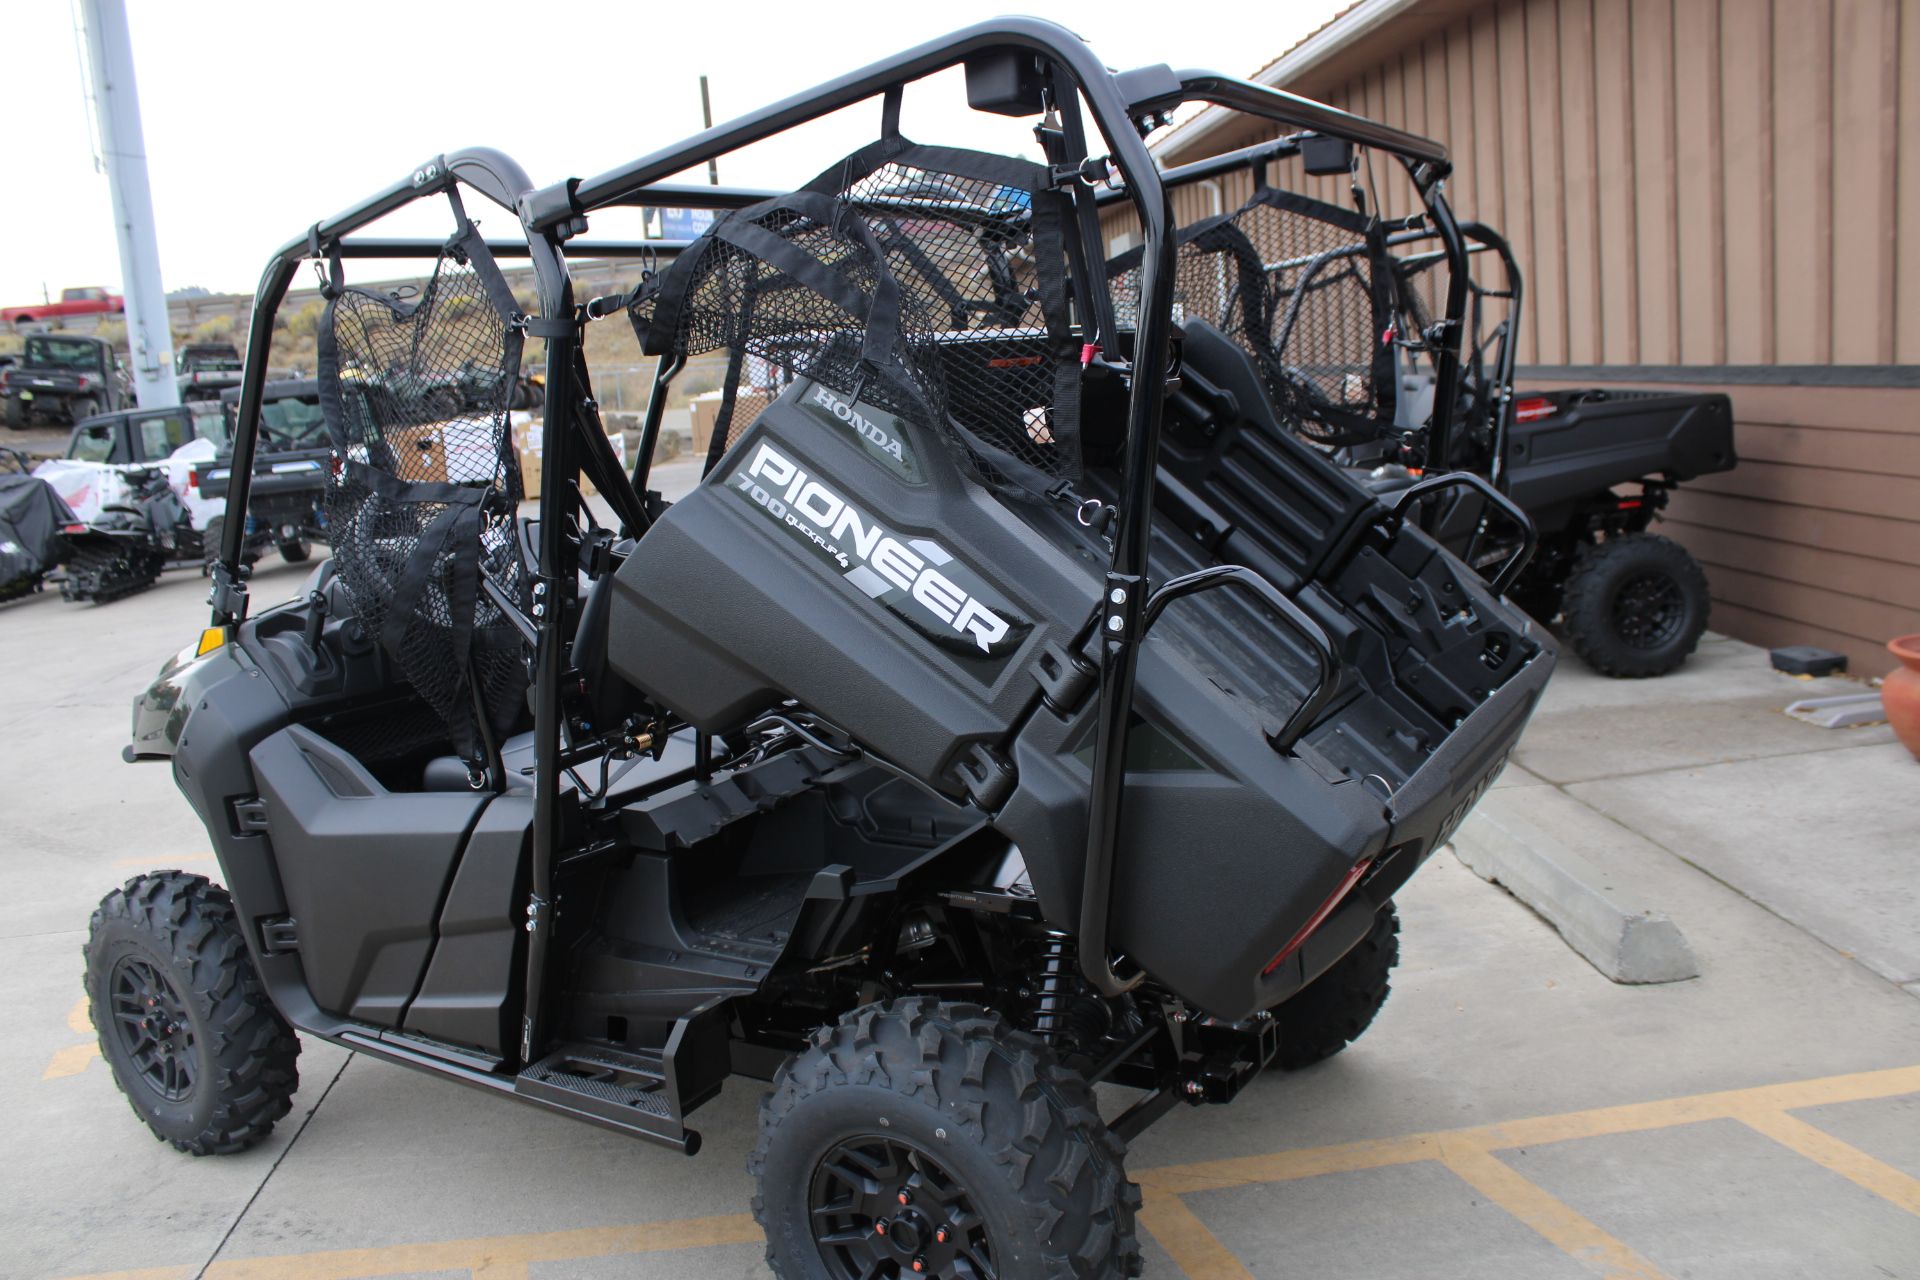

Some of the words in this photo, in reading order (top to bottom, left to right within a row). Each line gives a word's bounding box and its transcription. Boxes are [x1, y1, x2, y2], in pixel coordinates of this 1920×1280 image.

[814, 387, 903, 462] HONDA
[737, 472, 787, 519] 700
[749, 444, 1010, 653] PIONEER
